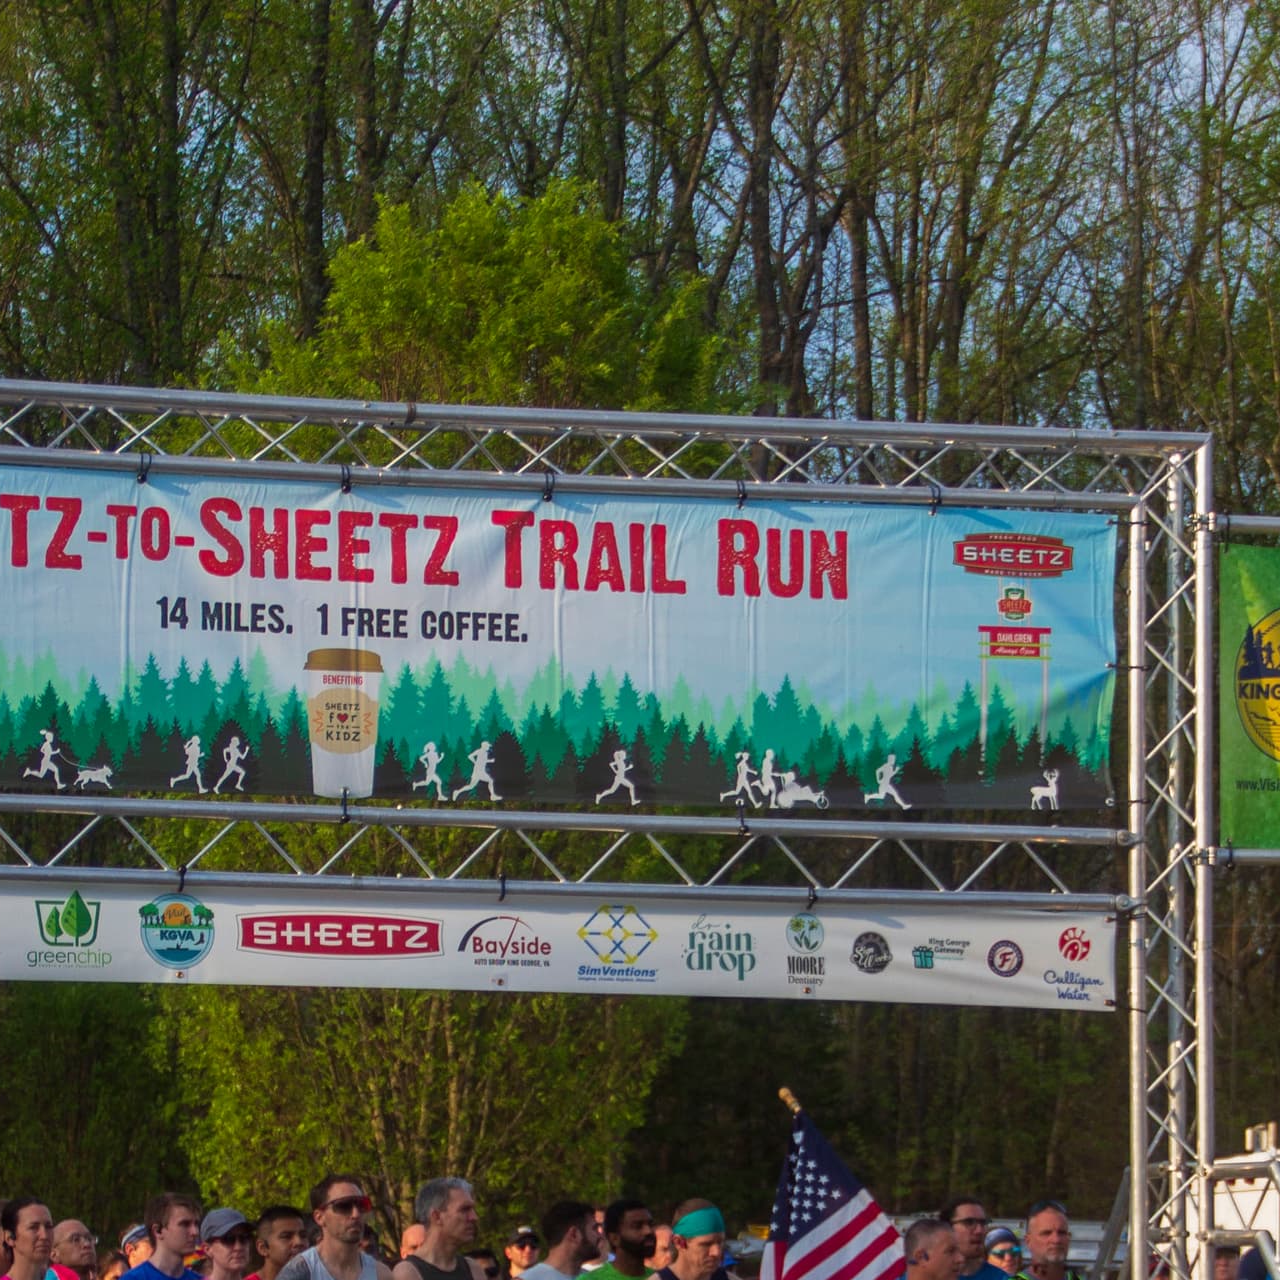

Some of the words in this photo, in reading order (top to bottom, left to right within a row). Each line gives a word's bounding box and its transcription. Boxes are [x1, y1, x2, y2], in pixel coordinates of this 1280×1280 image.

[492, 509, 686, 595] TRAIL
[717, 518, 849, 601] RUN
[963, 546, 1064, 565] SHEETZ
[156, 597, 187, 630] 14
[201, 600, 293, 635] MILES.
[315, 602, 329, 636] 1
[341, 606, 409, 639] FREE
[421, 610, 528, 643] COFFEE.
[997, 632, 1033, 643] DAHLGREN
[322, 674, 363, 686] BENEFITING
[324, 702, 361, 712] SHEETZ
[325, 731, 361, 742] KIDZ
[160, 929, 195, 942] KGVA
[253, 921, 430, 949] SHEETZ
[688, 923, 752, 952] rain
[945, 938, 971, 948] George
[472, 936, 552, 958] Bayside
[26, 948, 112, 969] greenchip
[685, 943, 757, 981] drop
[786, 956, 825, 976] MOORE
[577, 965, 657, 978] SimVentions
[787, 975, 825, 986] Dentistry
[1043, 969, 1104, 990] Culligan
[1056, 987, 1091, 1001] Water
